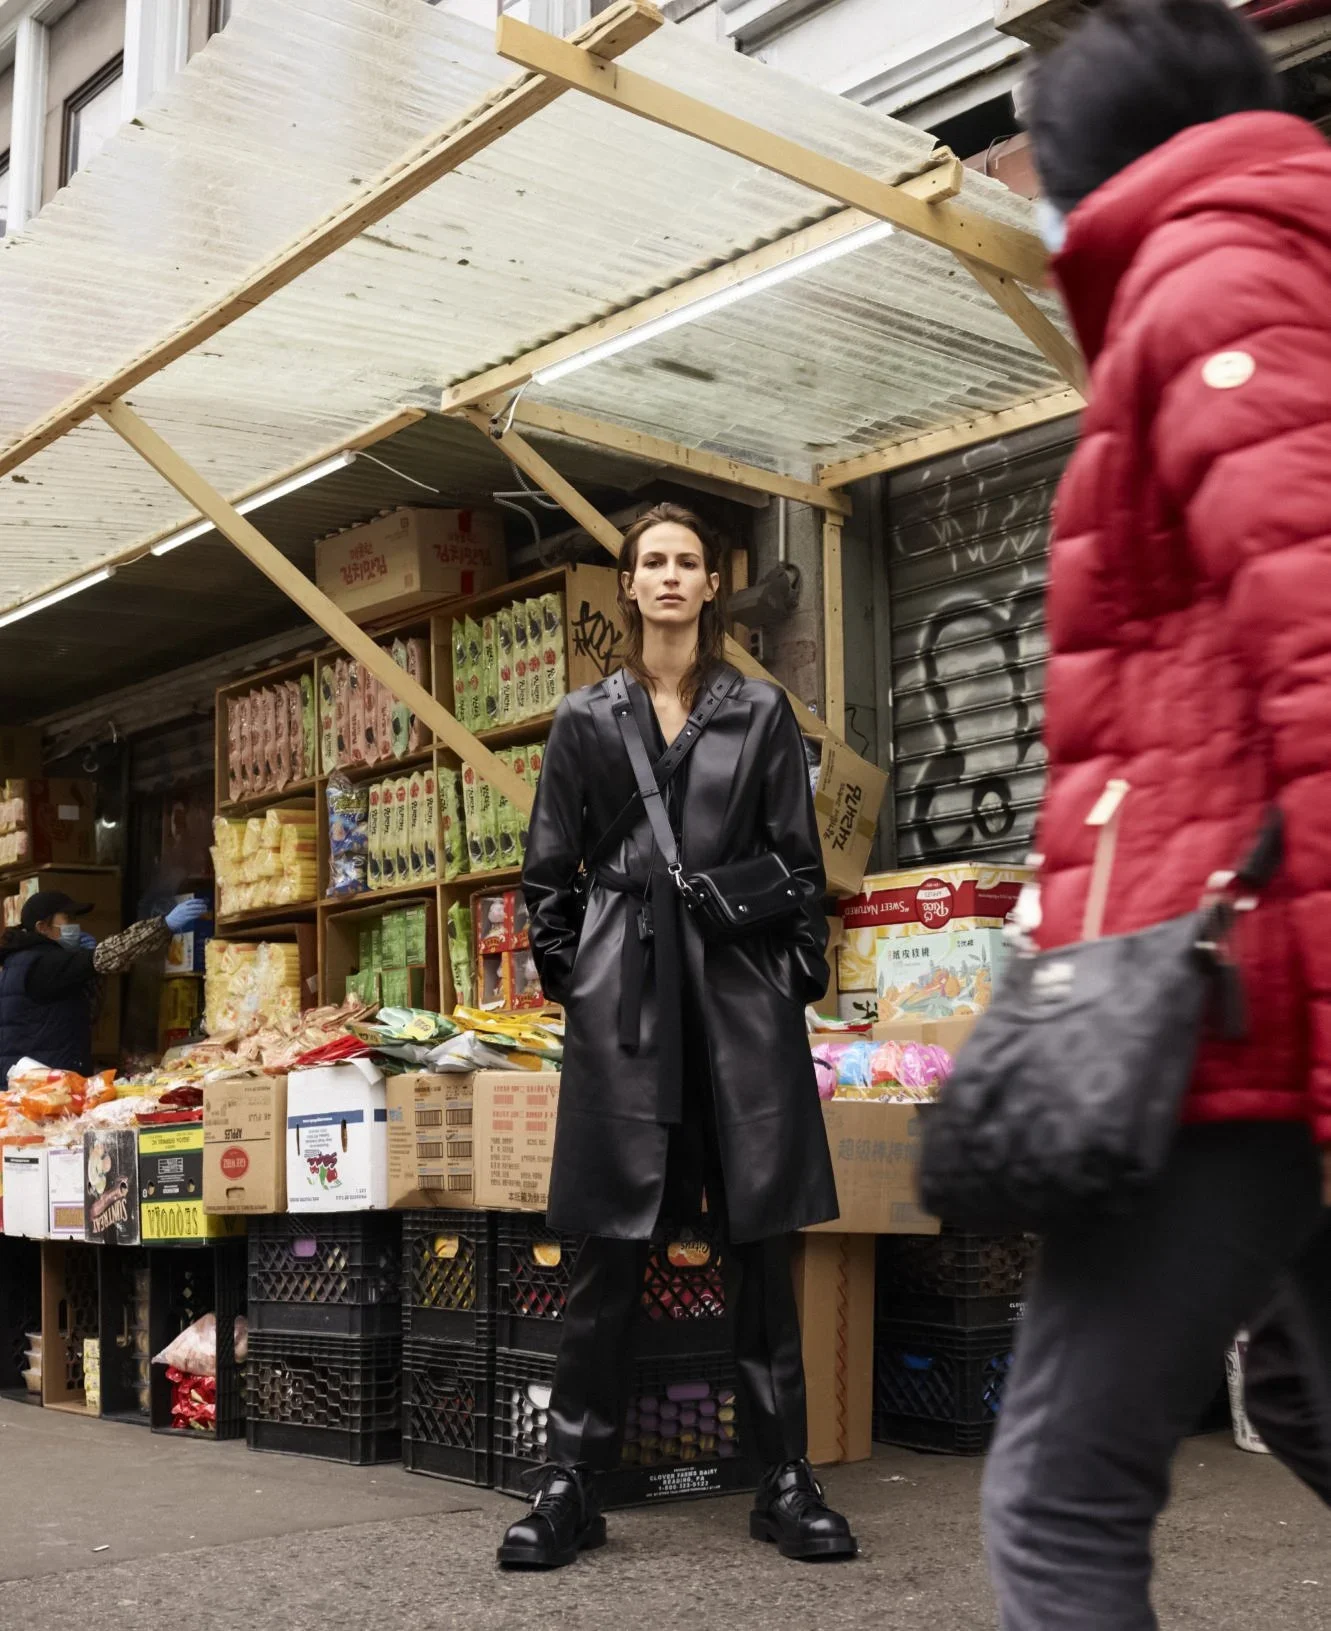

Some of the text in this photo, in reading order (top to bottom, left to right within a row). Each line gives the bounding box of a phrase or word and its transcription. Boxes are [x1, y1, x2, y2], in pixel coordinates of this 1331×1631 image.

[920, 902, 949, 918] Rice
[224, 1127, 243, 1141] APPLES
[92, 1198, 128, 1234] SUNTREAT
[147, 1205, 199, 1239] SEQUOIA
[649, 1473, 675, 1481] CLOVER
